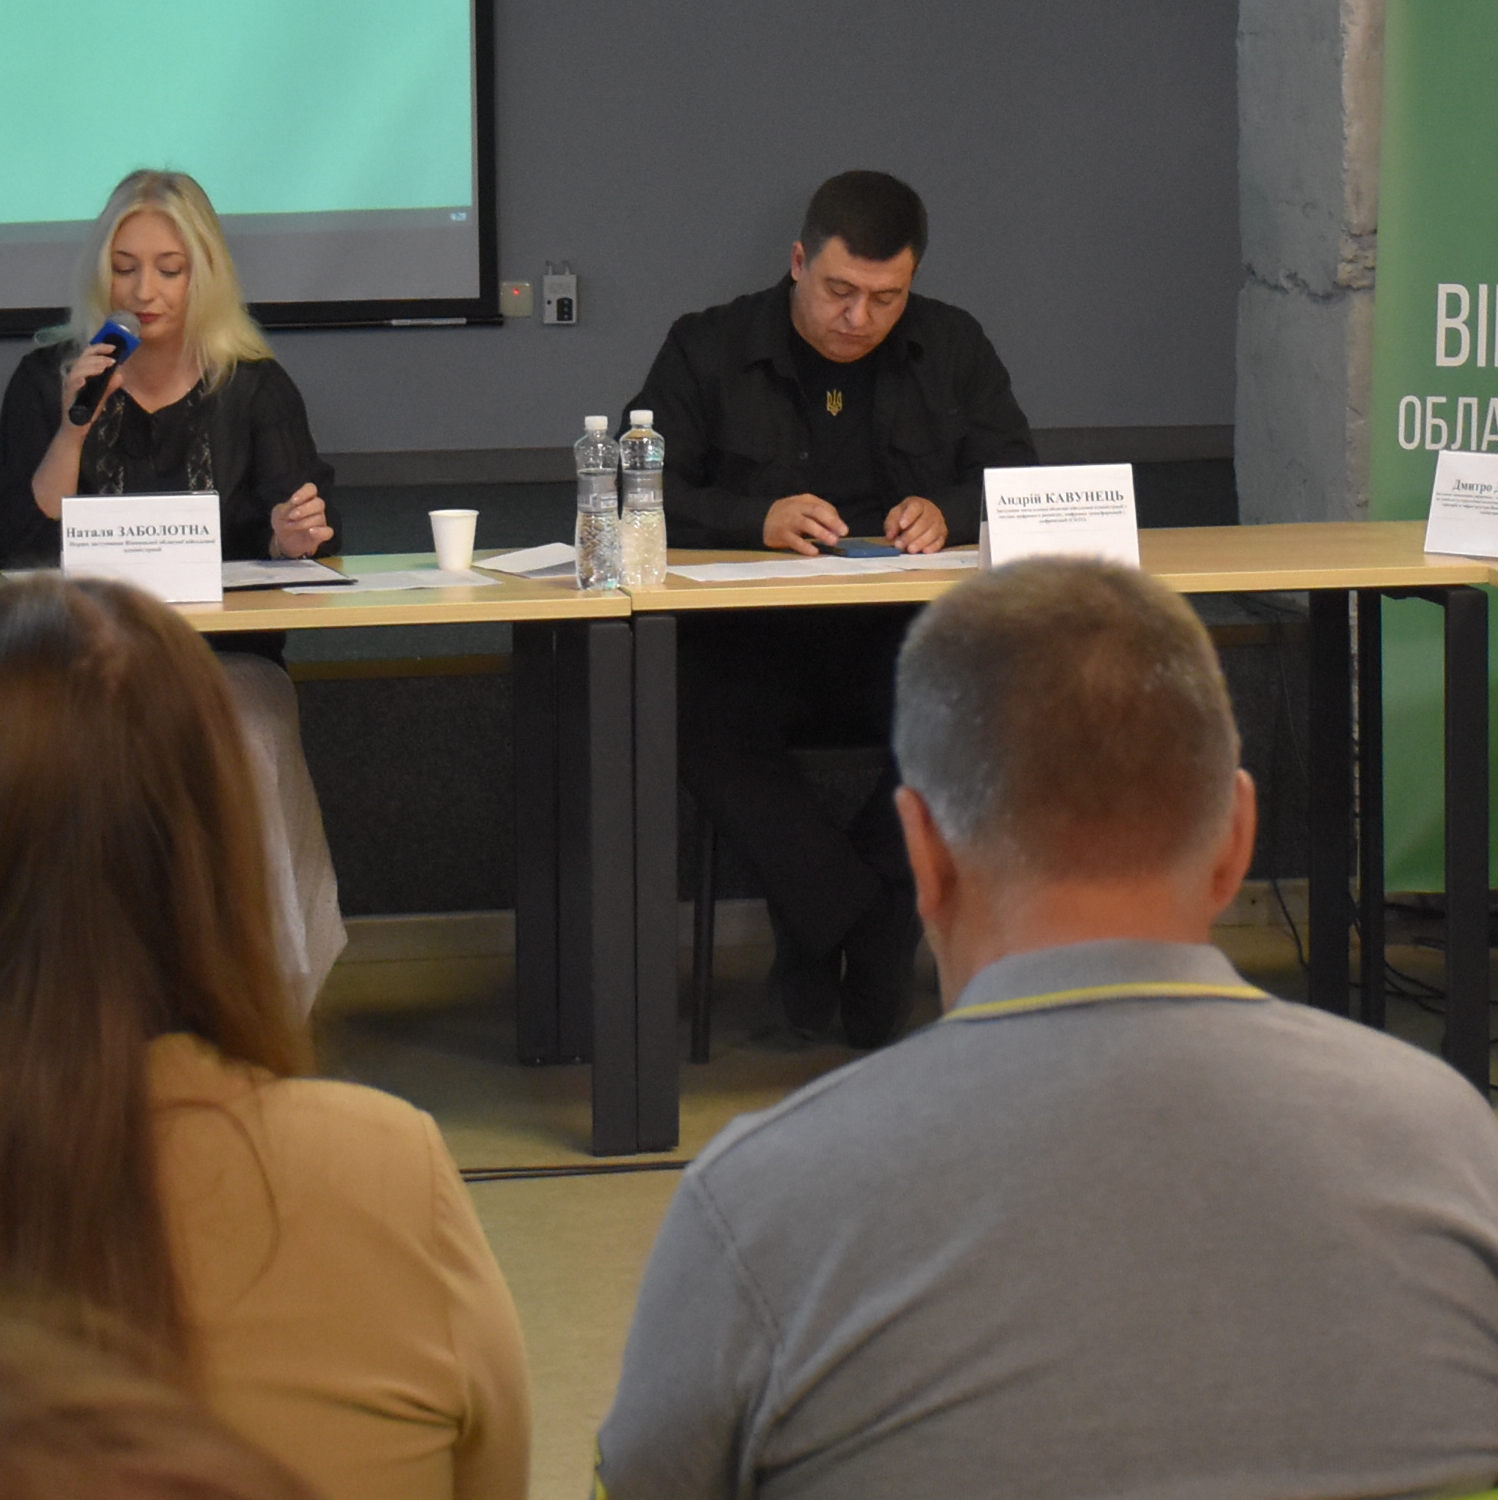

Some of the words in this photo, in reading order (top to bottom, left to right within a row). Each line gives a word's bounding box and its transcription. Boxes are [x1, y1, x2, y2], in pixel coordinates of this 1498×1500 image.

[1452, 479, 1493, 495] Дмитро
[997, 493, 1042, 508] Андрій
[1045, 490, 1125, 505] КАВУНЕЦЬ
[66, 527, 114, 539] Наталя
[118, 524, 210, 537] ЗАБОЛОТНА
